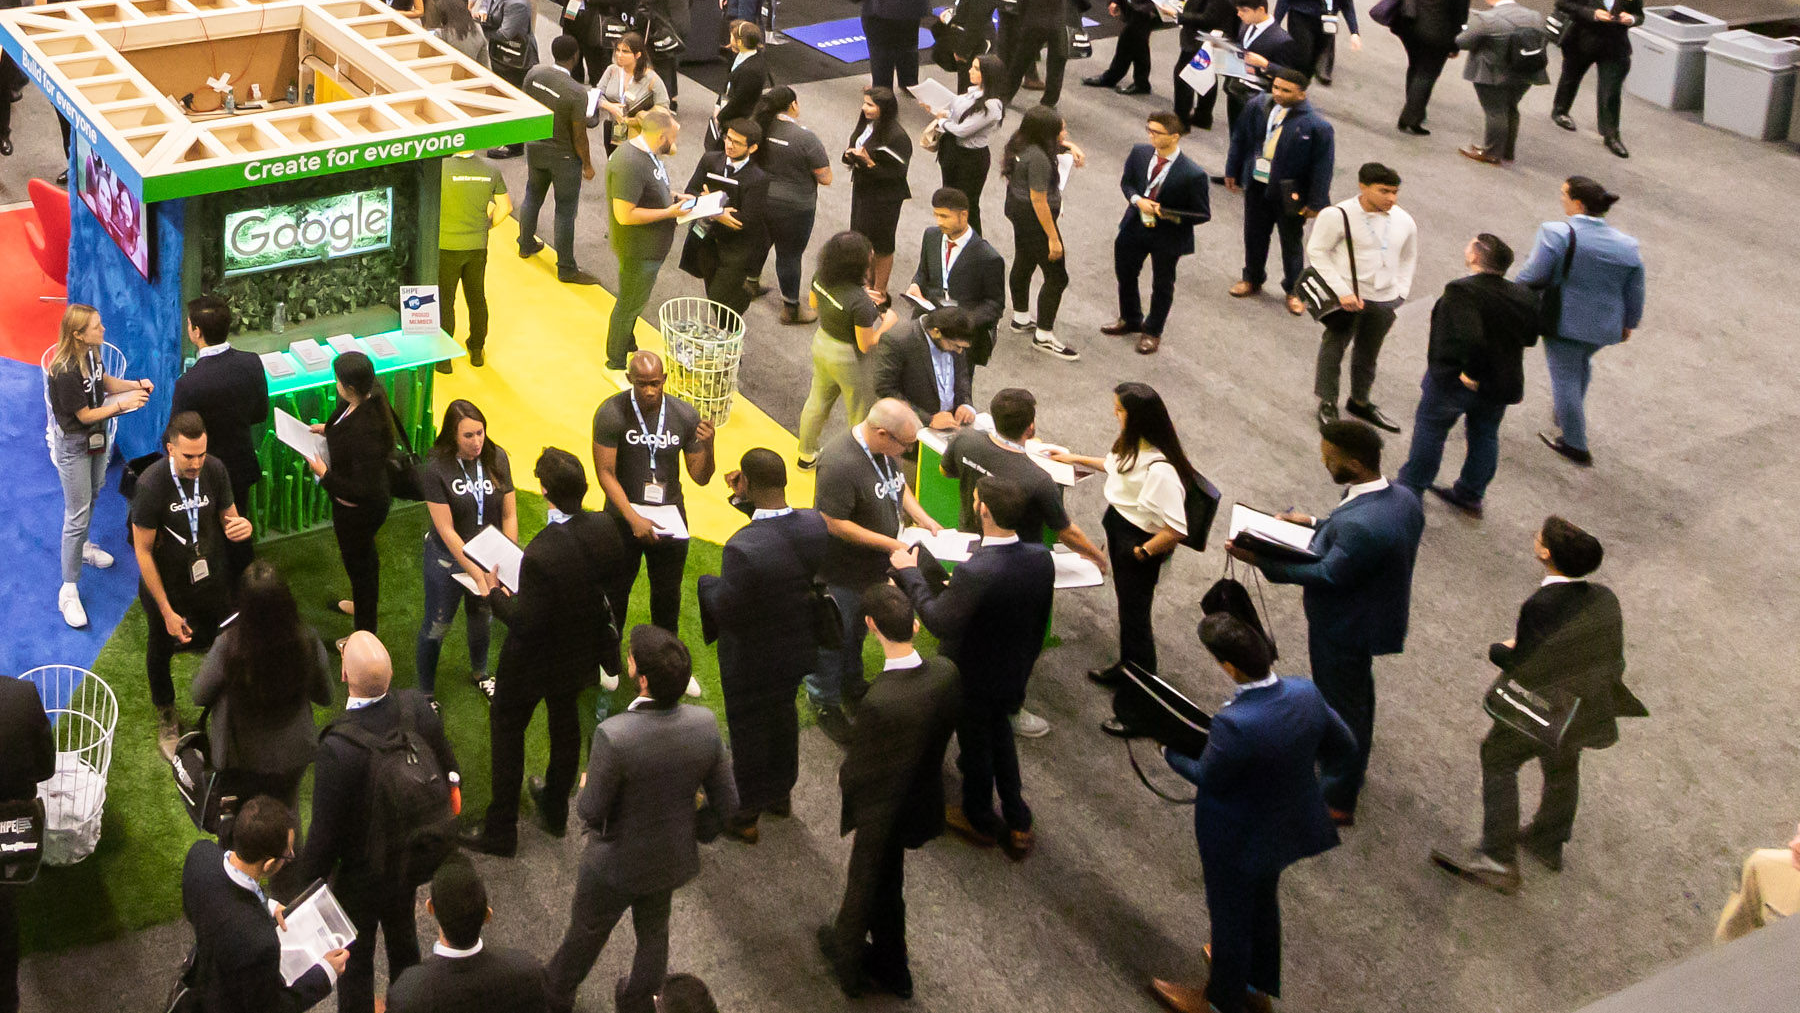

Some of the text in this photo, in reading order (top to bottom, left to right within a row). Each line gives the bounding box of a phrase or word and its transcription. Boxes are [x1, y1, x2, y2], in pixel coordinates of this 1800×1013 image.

[22, 49, 97, 145] Build for everyone
[243, 132, 466, 183] Create for everyone
[230, 191, 388, 257] Google
